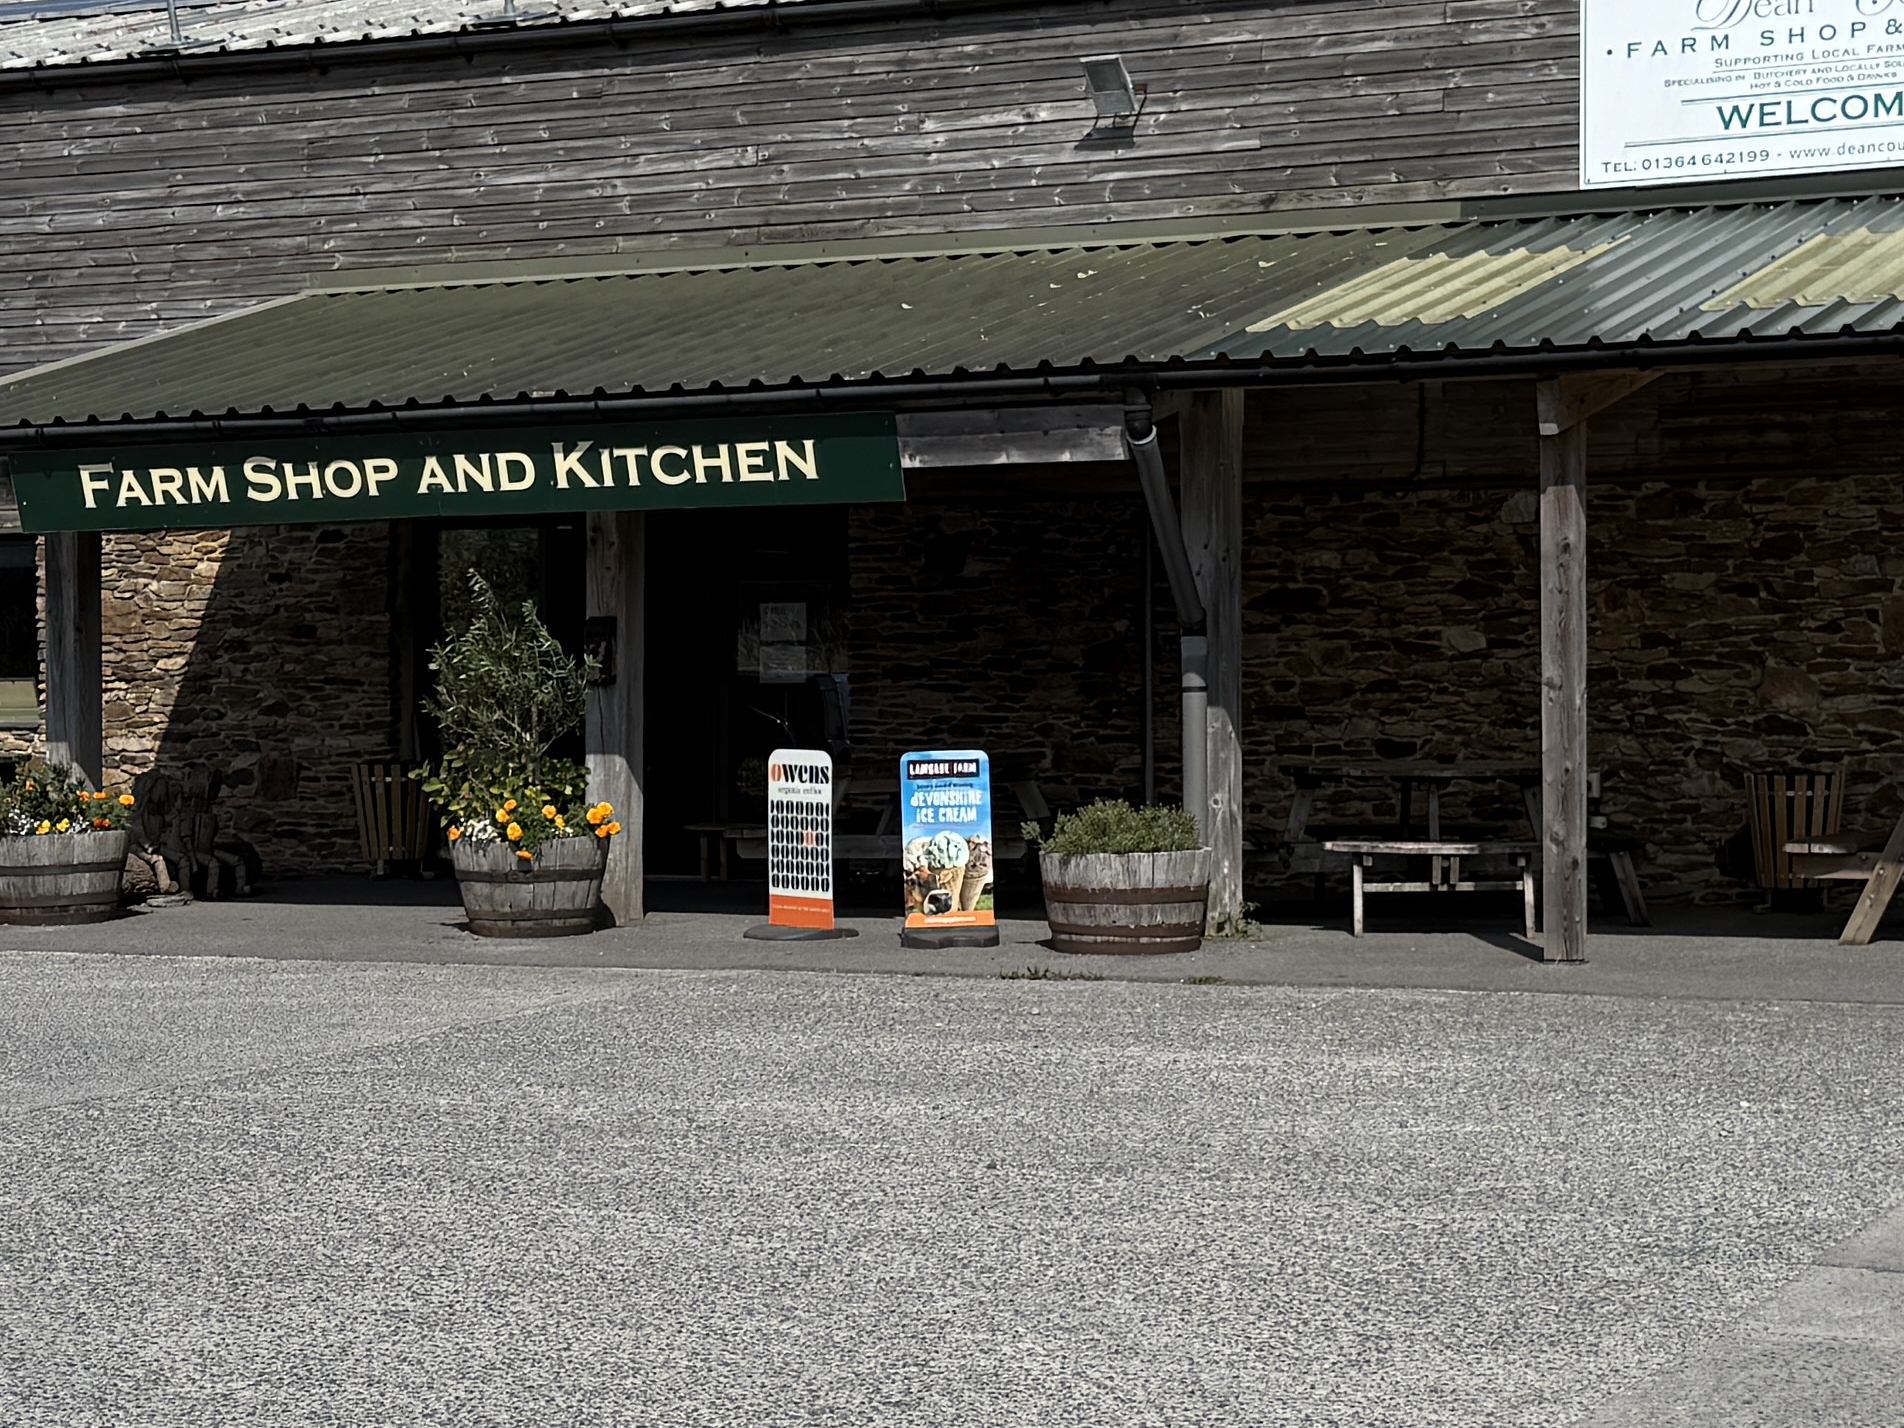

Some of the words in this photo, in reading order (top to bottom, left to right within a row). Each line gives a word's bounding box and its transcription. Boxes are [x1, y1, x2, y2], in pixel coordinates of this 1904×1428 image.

[1626, 34, 1730, 59] FARM
[1759, 21, 1867, 47] SHOP
[1885, 18, 1903, 36] &
[1714, 52, 1804, 68] SUPPORTING
[1812, 47, 1860, 60] LOCAL
[1753, 68, 1807, 80] BUTCHERY
[1811, 66, 1832, 74] AND
[1835, 62, 1880, 73] LOCALLY
[1784, 78, 1813, 87] COLD
[1816, 75, 1844, 84] FOOD
[78, 461, 231, 509] FARM
[242, 456, 399, 502] SHOP
[417, 450, 536, 494] AND
[550, 439, 820, 489] KITCHEN
